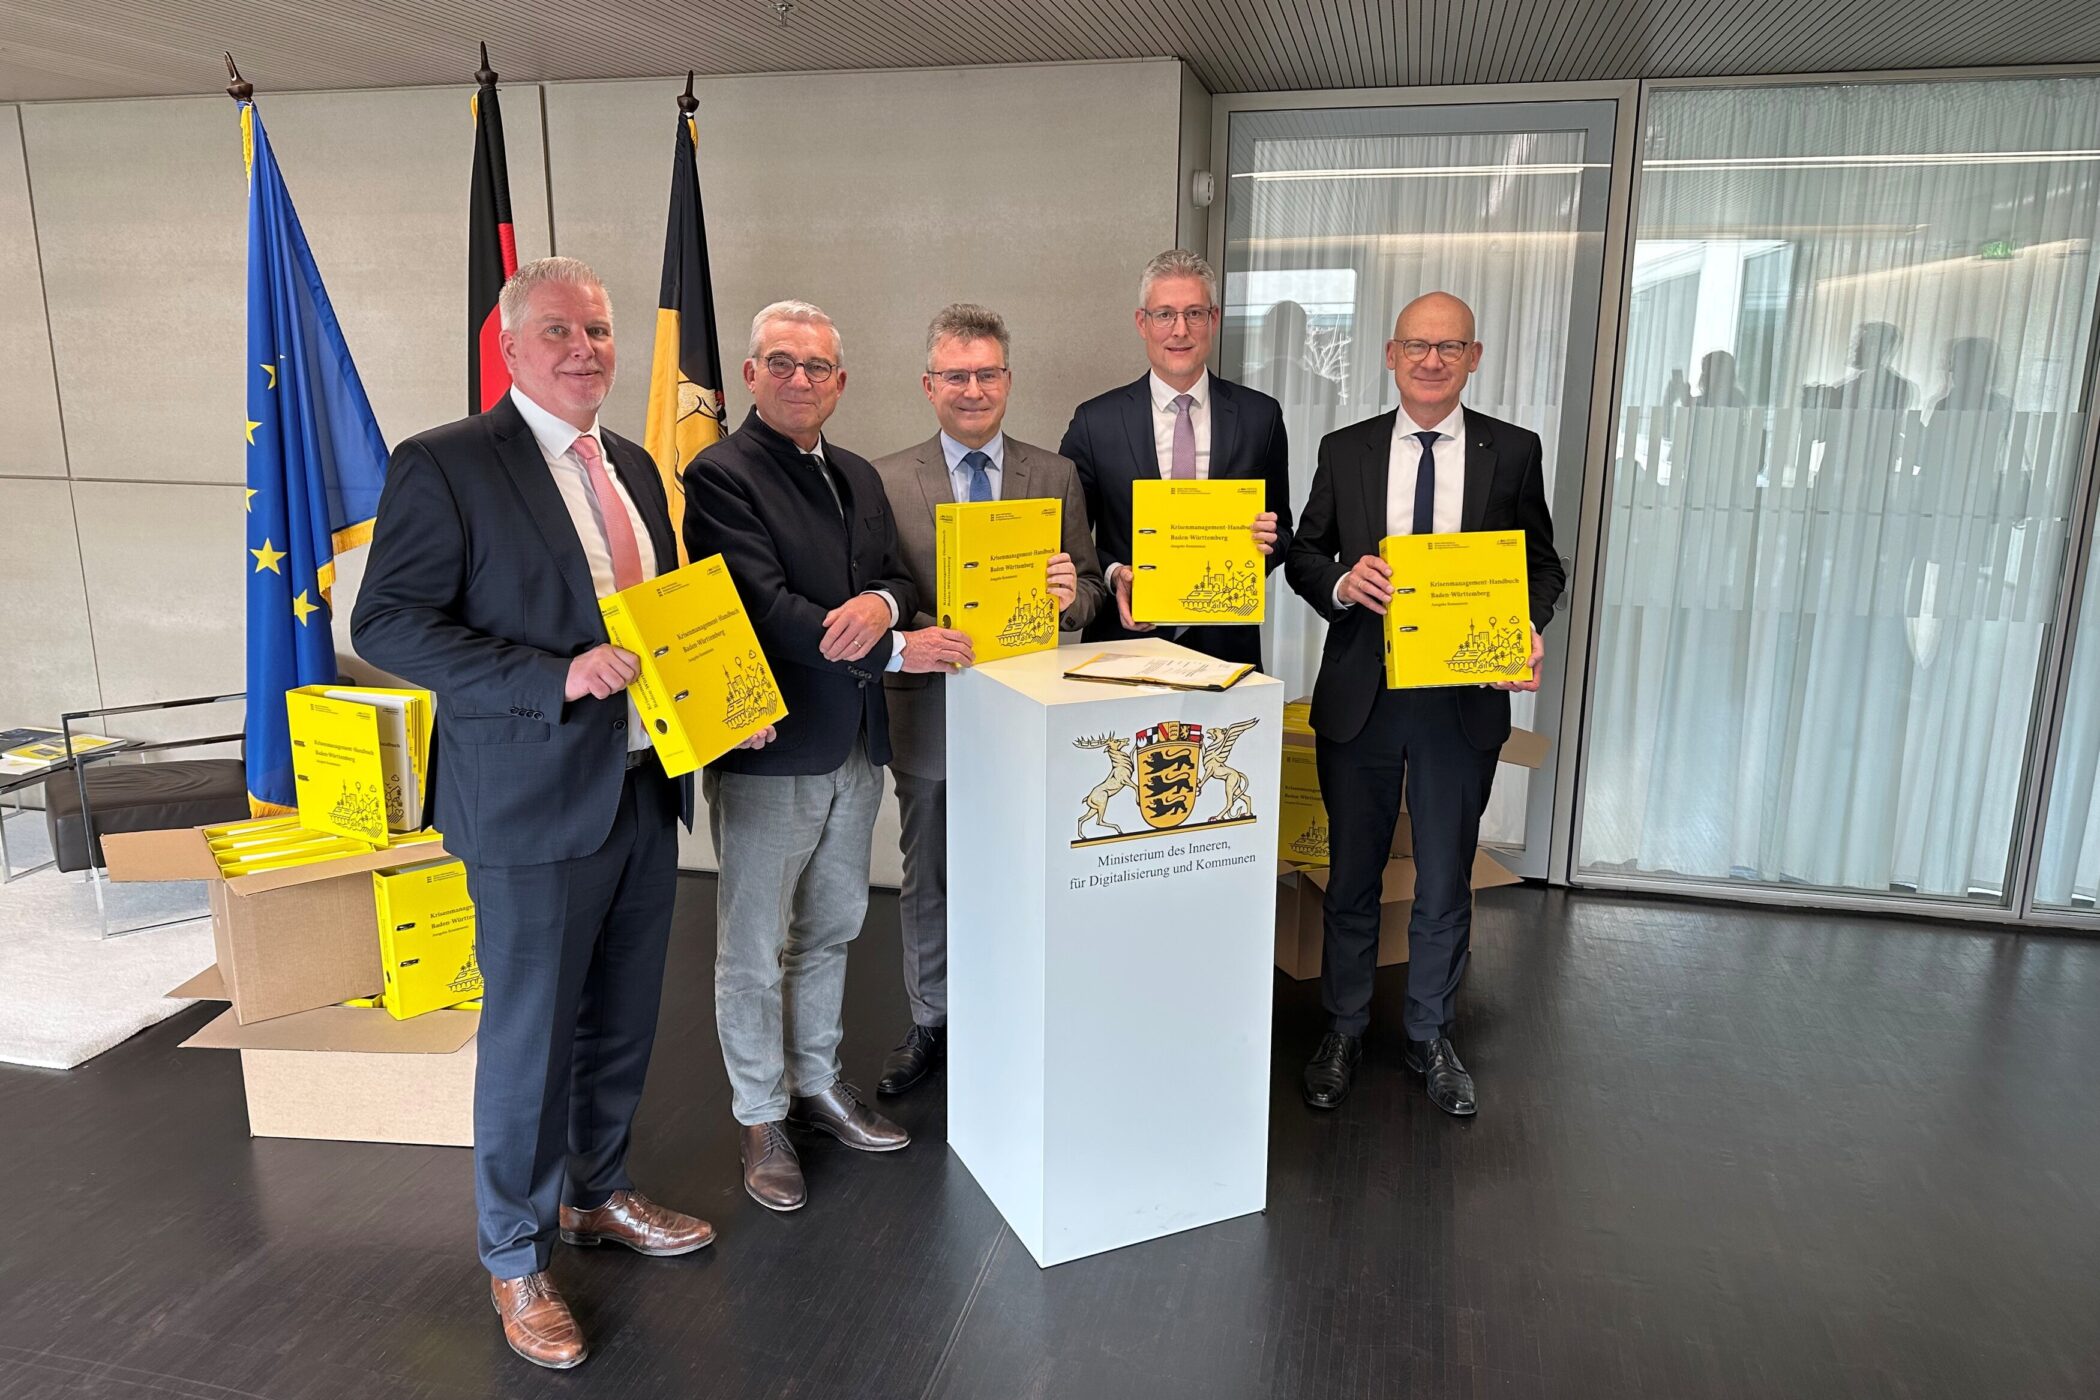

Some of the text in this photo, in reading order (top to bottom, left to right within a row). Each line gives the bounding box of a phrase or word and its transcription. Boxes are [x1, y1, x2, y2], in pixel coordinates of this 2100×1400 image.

[1430, 578, 1520, 588] Krisenmanagement-Handbuch
[1431, 590, 1491, 599] Baden-Württemberg
[1098, 840, 1231, 868] Ministerium des Inneren,
[1070, 853, 1257, 890] für Digitalisierung und Kommunen
